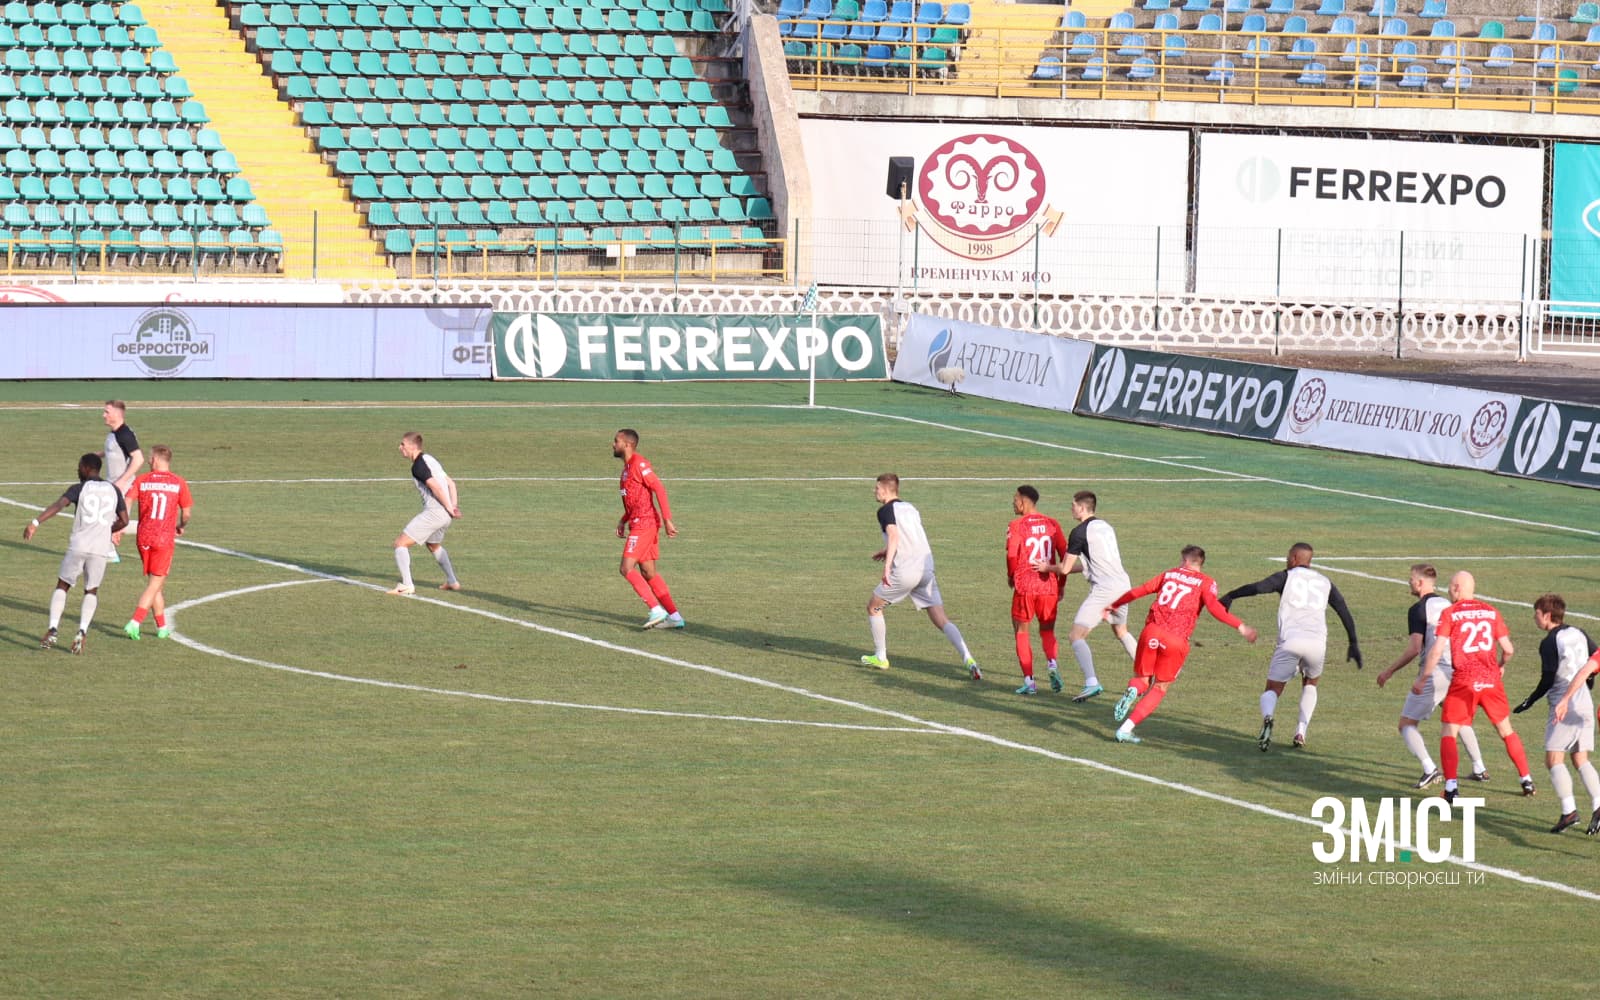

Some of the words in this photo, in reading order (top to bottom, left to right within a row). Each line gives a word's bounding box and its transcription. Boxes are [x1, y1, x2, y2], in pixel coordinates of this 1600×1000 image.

[1290, 166, 1506, 208] FERREXPO
[950, 201, 1014, 218] Фарро
[967, 242, 993, 255] 1998
[117, 341, 209, 355] ФЕРРОСТРОЙ
[578, 325, 873, 371] FERREXPO
[955, 341, 1052, 387] ARTERIUM
[1122, 363, 1284, 428] FERREXPO
[83, 493, 114, 525] 92
[150, 492, 167, 520] 11
[1025, 535, 1052, 564] 20
[1158, 580, 1192, 610] 87
[1288, 578, 1325, 610] 95
[1461, 620, 1493, 654] 23
